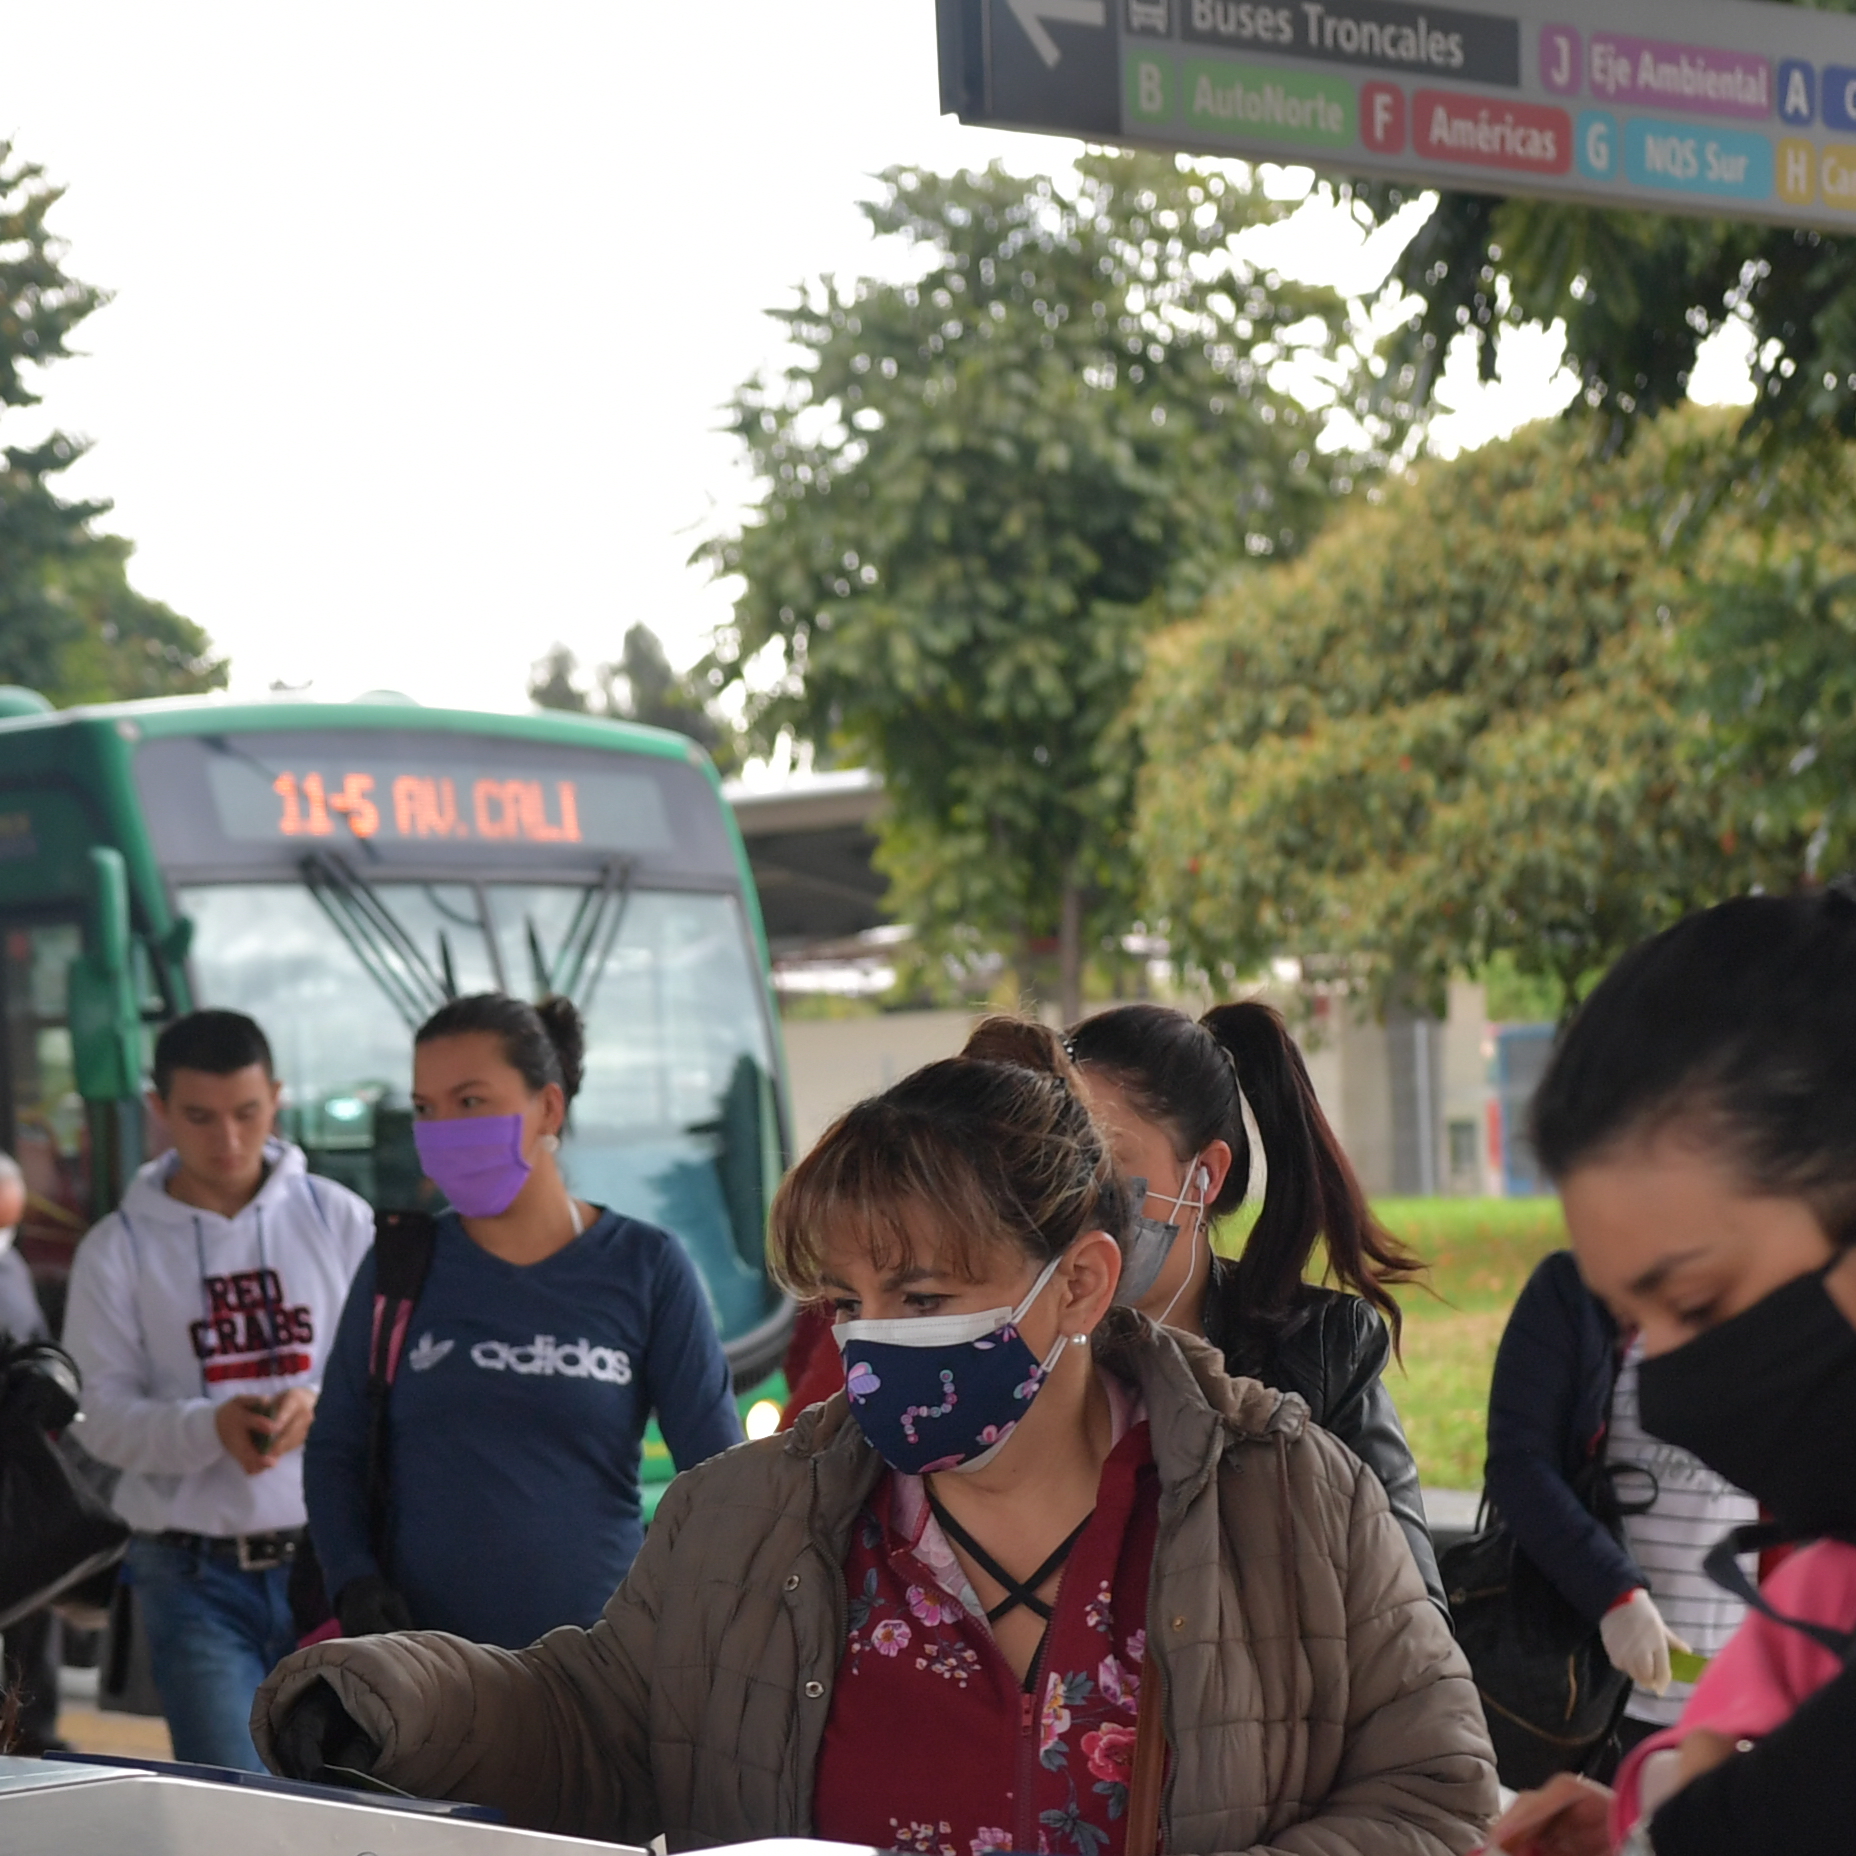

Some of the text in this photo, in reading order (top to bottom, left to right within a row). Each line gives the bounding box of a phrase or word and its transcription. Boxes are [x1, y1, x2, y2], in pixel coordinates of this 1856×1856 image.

[1191, 0, 1465, 69] Buses Troncales
[1138, 61, 1344, 134] B AutoNorte
[1552, 36, 1770, 108] J Eje Ambiental
[1784, 67, 1809, 117] A
[1372, 92, 1557, 162] F Américas
[1586, 122, 1748, 183] G NQS Sur
[1786, 148, 1807, 194] H
[274, 770, 381, 839] 11-5
[203, 1270, 283, 1312] RED
[189, 1306, 313, 1360] CRABS
[470, 1334, 633, 1386] adidas
